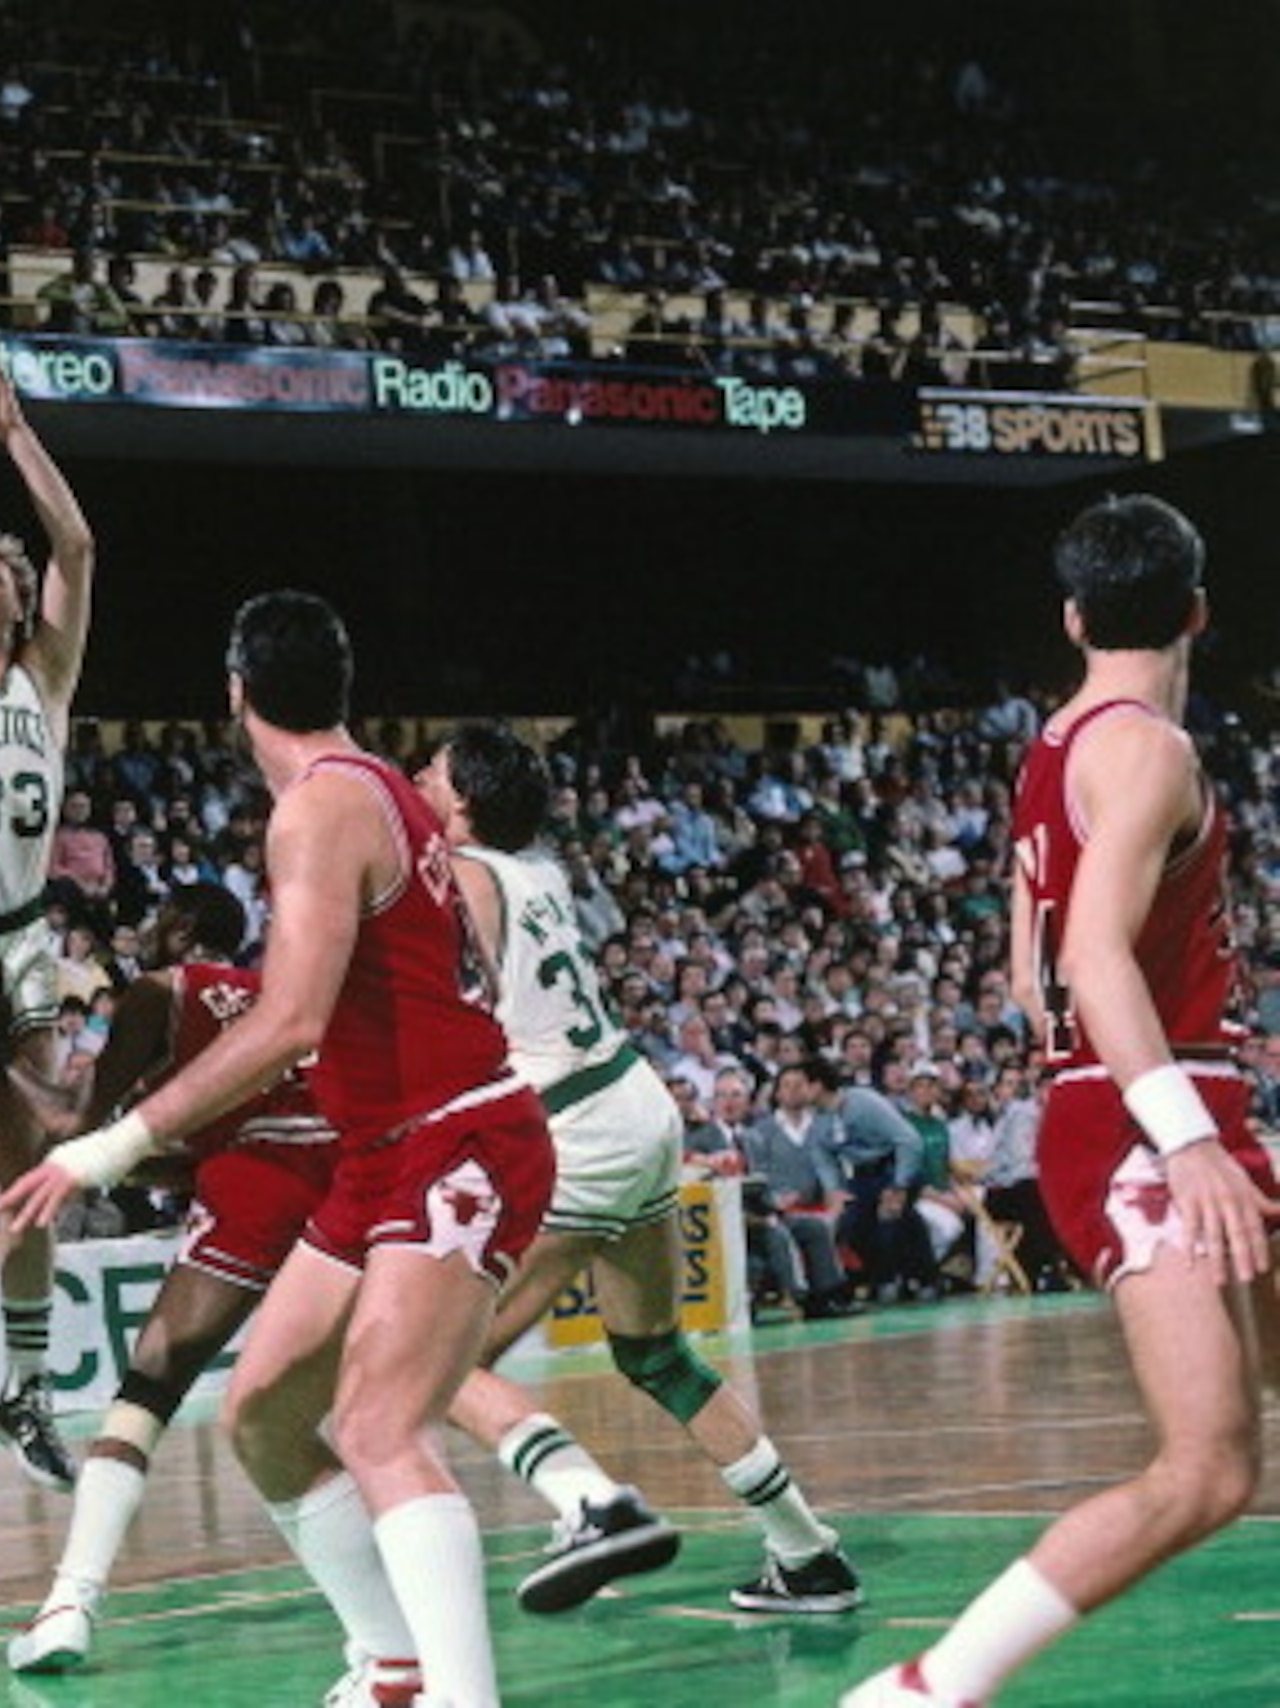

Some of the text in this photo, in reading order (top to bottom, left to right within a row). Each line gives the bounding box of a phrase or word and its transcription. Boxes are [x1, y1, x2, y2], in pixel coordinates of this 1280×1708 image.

[123, 347, 366, 403] Panasonic
[373, 359, 492, 413] Radio
[495, 365, 716, 424] Panasonic
[716, 377, 806, 432] Tape
[992, 407, 1141, 455] SPORTS
